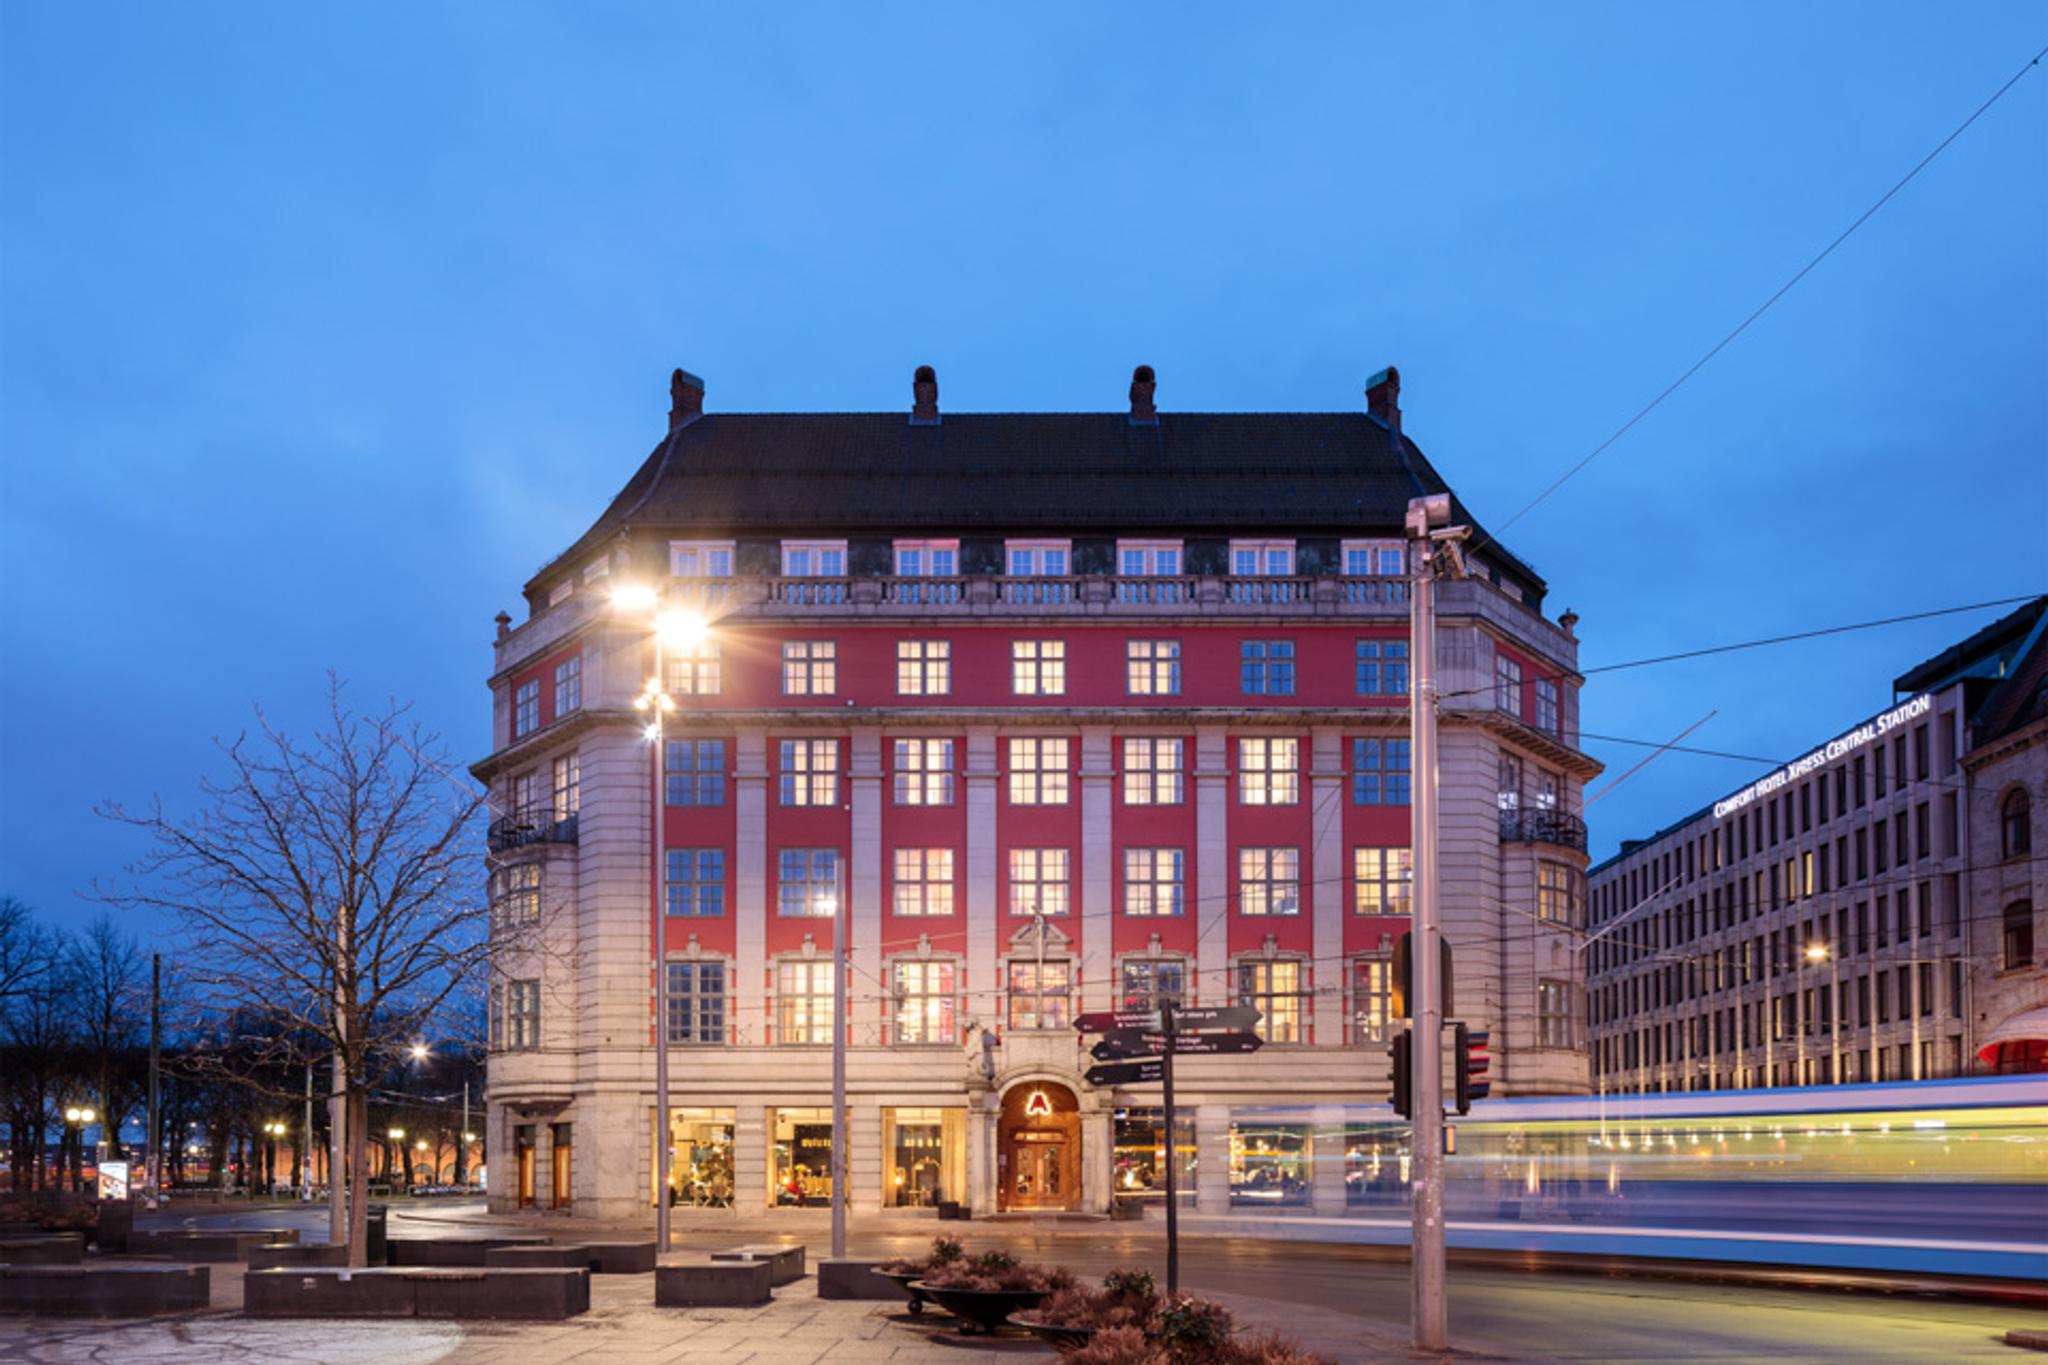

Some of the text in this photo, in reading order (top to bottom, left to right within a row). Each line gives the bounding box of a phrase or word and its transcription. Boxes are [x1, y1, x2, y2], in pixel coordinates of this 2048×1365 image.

[1755, 770, 1787, 797] HOTEL
[1826, 724, 1876, 760] CENTRAL
[1877, 694, 1930, 735] STATION
[1026, 1092, 1052, 1116] A
